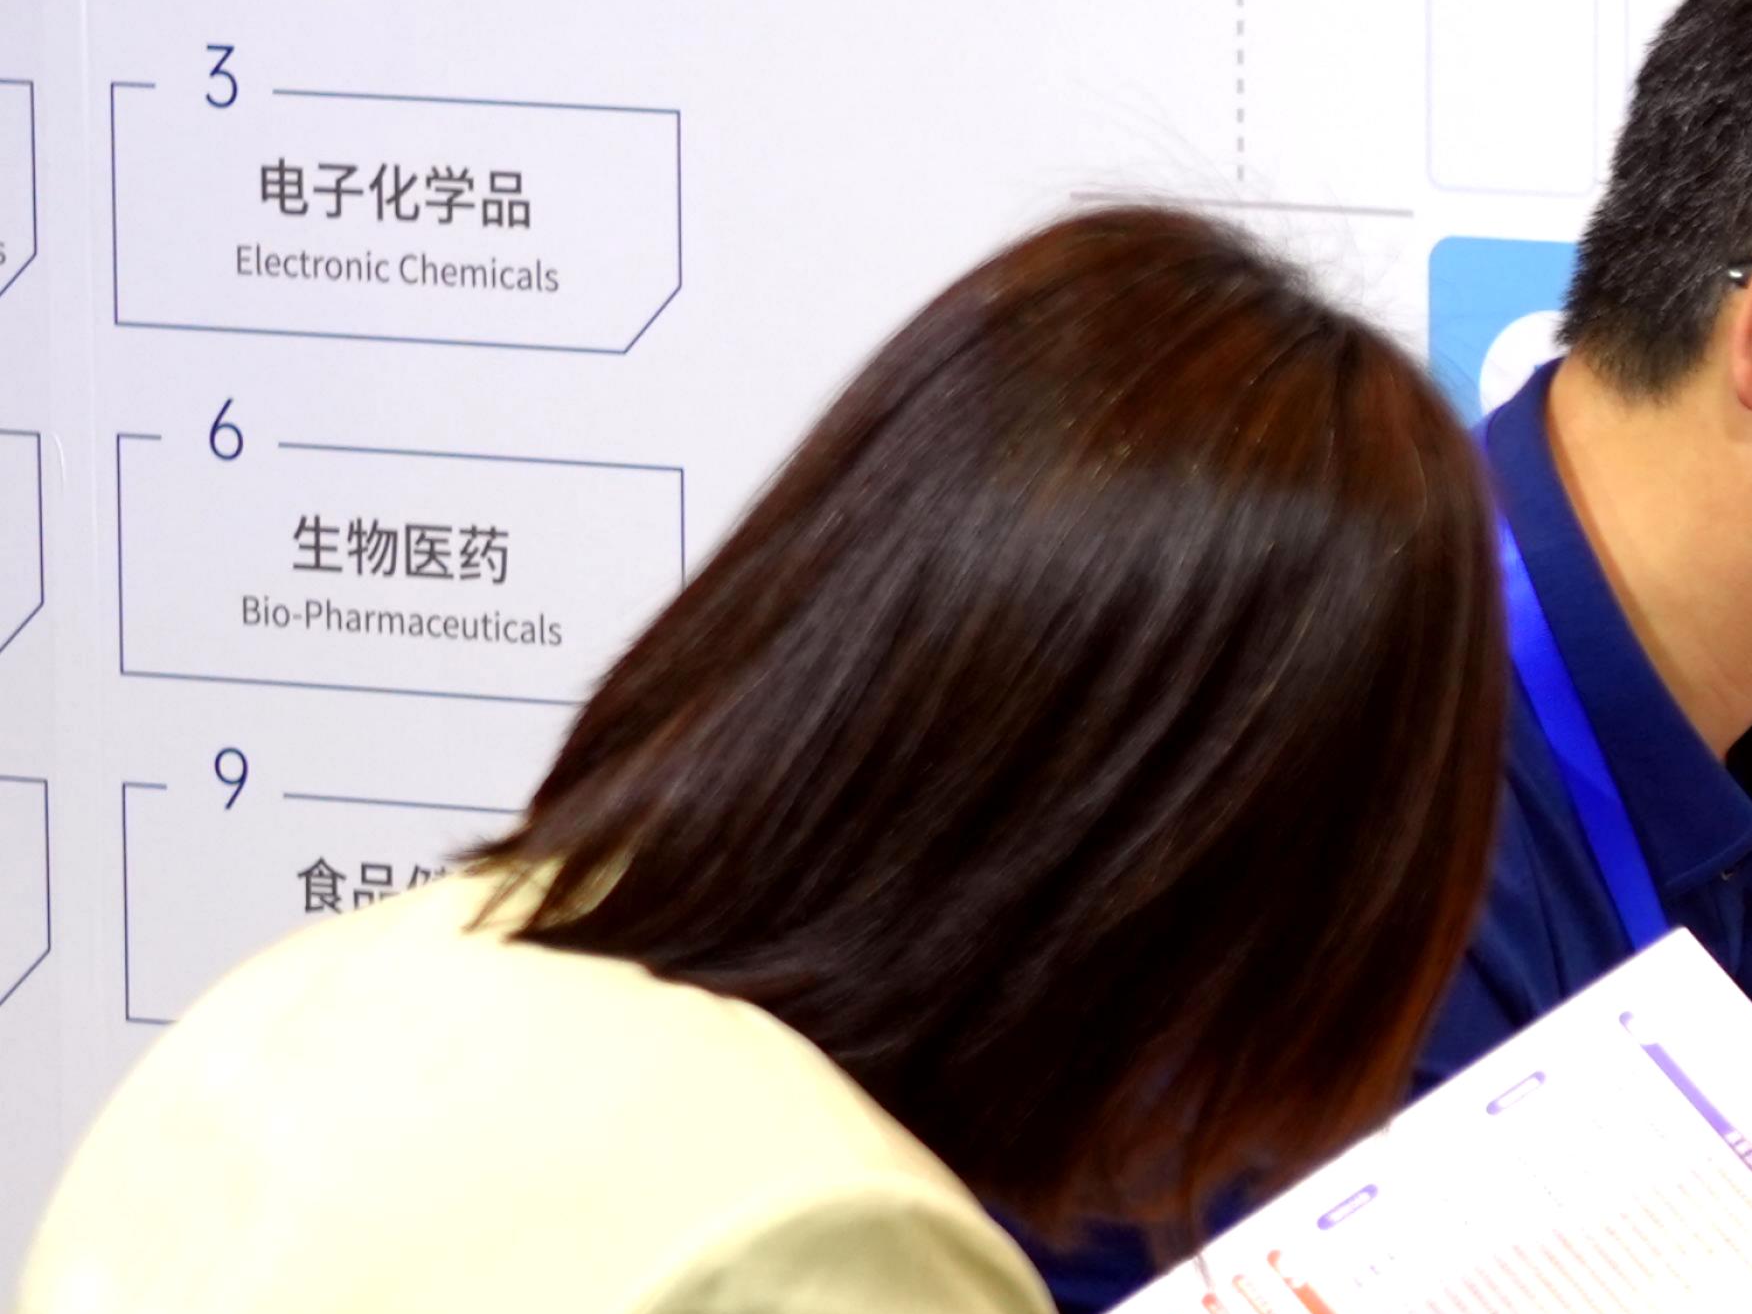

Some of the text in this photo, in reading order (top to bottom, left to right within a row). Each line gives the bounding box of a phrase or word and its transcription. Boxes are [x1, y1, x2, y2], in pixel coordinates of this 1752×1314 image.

[206, 45, 239, 110] 3
[261, 158, 532, 230] 电子化学品
[237, 245, 560, 294] Electronic Chemicals
[210, 399, 245, 462] 6
[293, 515, 510, 586] 生物医药
[243, 596, 563, 647] Bio-Pharmaceuticals
[215, 748, 250, 811] 9
